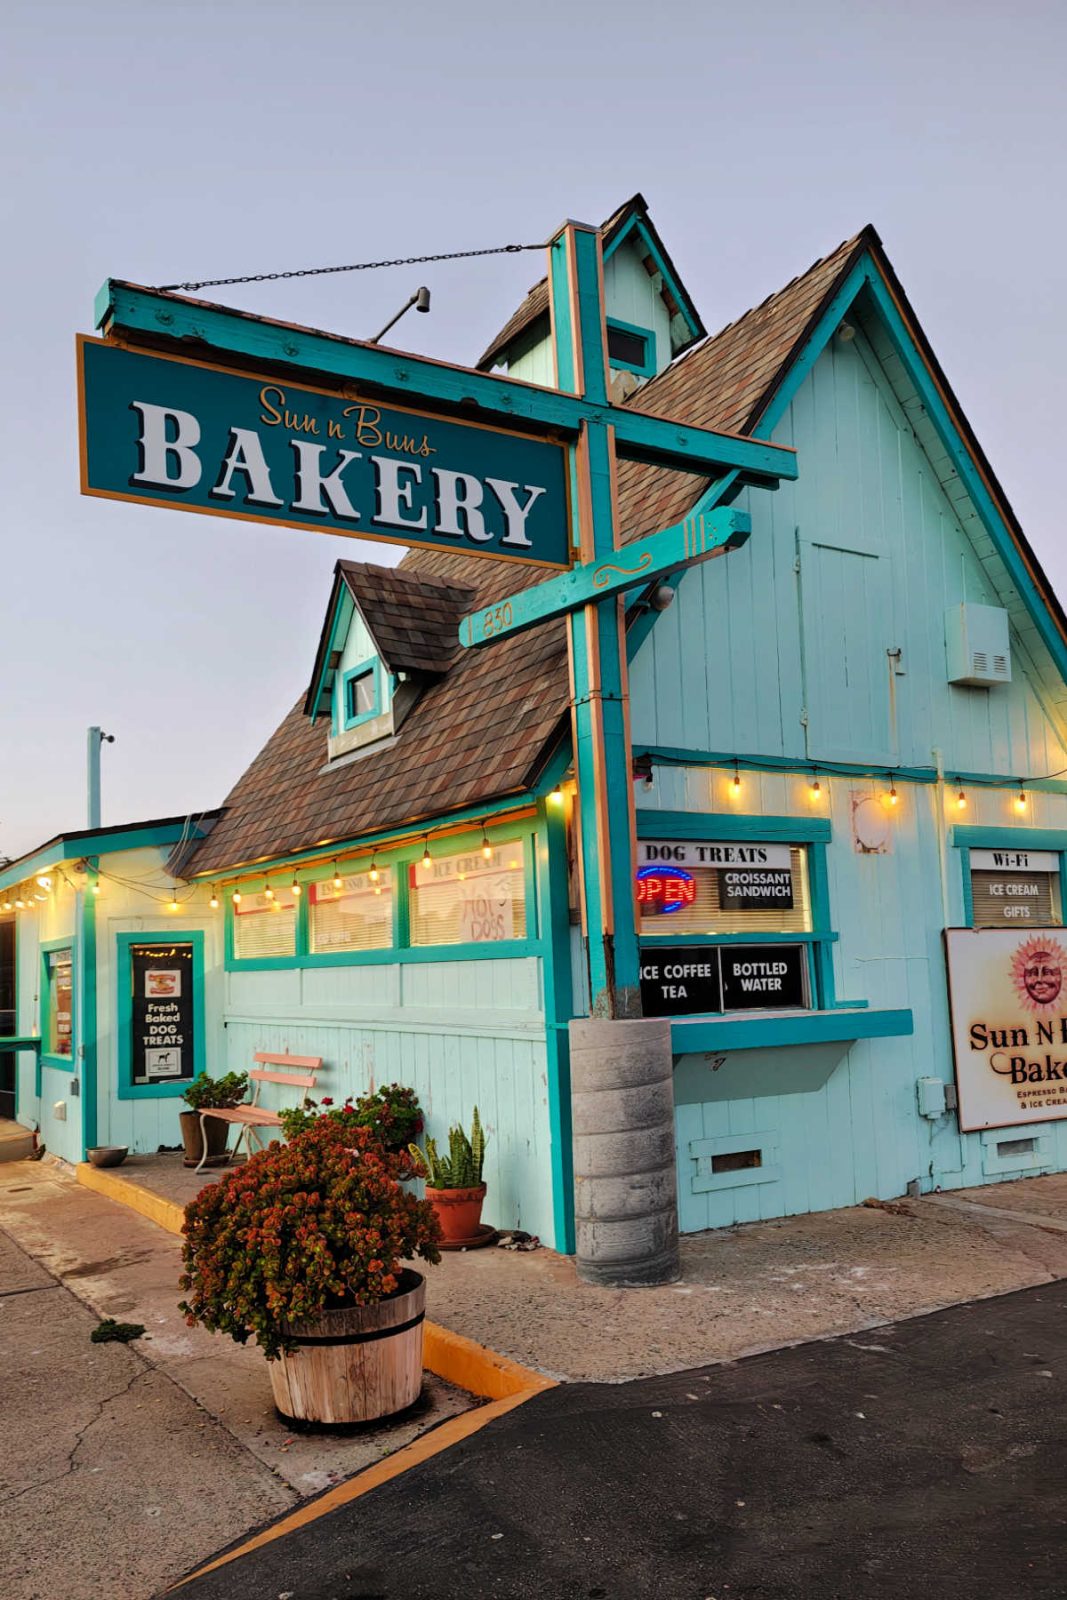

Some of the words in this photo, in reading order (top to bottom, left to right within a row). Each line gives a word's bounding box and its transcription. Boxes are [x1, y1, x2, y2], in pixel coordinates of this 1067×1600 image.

[259, 386, 320, 436] Sun
[328, 417, 344, 439] n
[343, 405, 436, 457] Buns
[131, 401, 547, 549] BAKERY
[482, 602, 513, 638] 830
[645, 845, 686, 861] DOG
[696, 846, 768, 863] TREATS
[993, 853, 1028, 867] Wi-Fi
[725, 873, 790, 885] CROISSANT
[727, 885, 791, 897] SANDWICH
[989, 884, 1004, 895] ICE
[1006, 884, 1039, 895] CREAM
[1003, 906, 1031, 918] GIFTS
[664, 964, 711, 979] COFFEE
[733, 962, 788, 976] BOTTLED
[740, 978, 782, 991] WATER
[661, 985, 688, 999] TEA
[147, 1003, 178, 1013] Fresh
[145, 1013, 180, 1023] Baked
[150, 1025, 177, 1035] DOG
[970, 1023, 1030, 1050] Sun
[1035, 1021, 1055, 1045] N
[143, 1035, 184, 1045] TREATS
